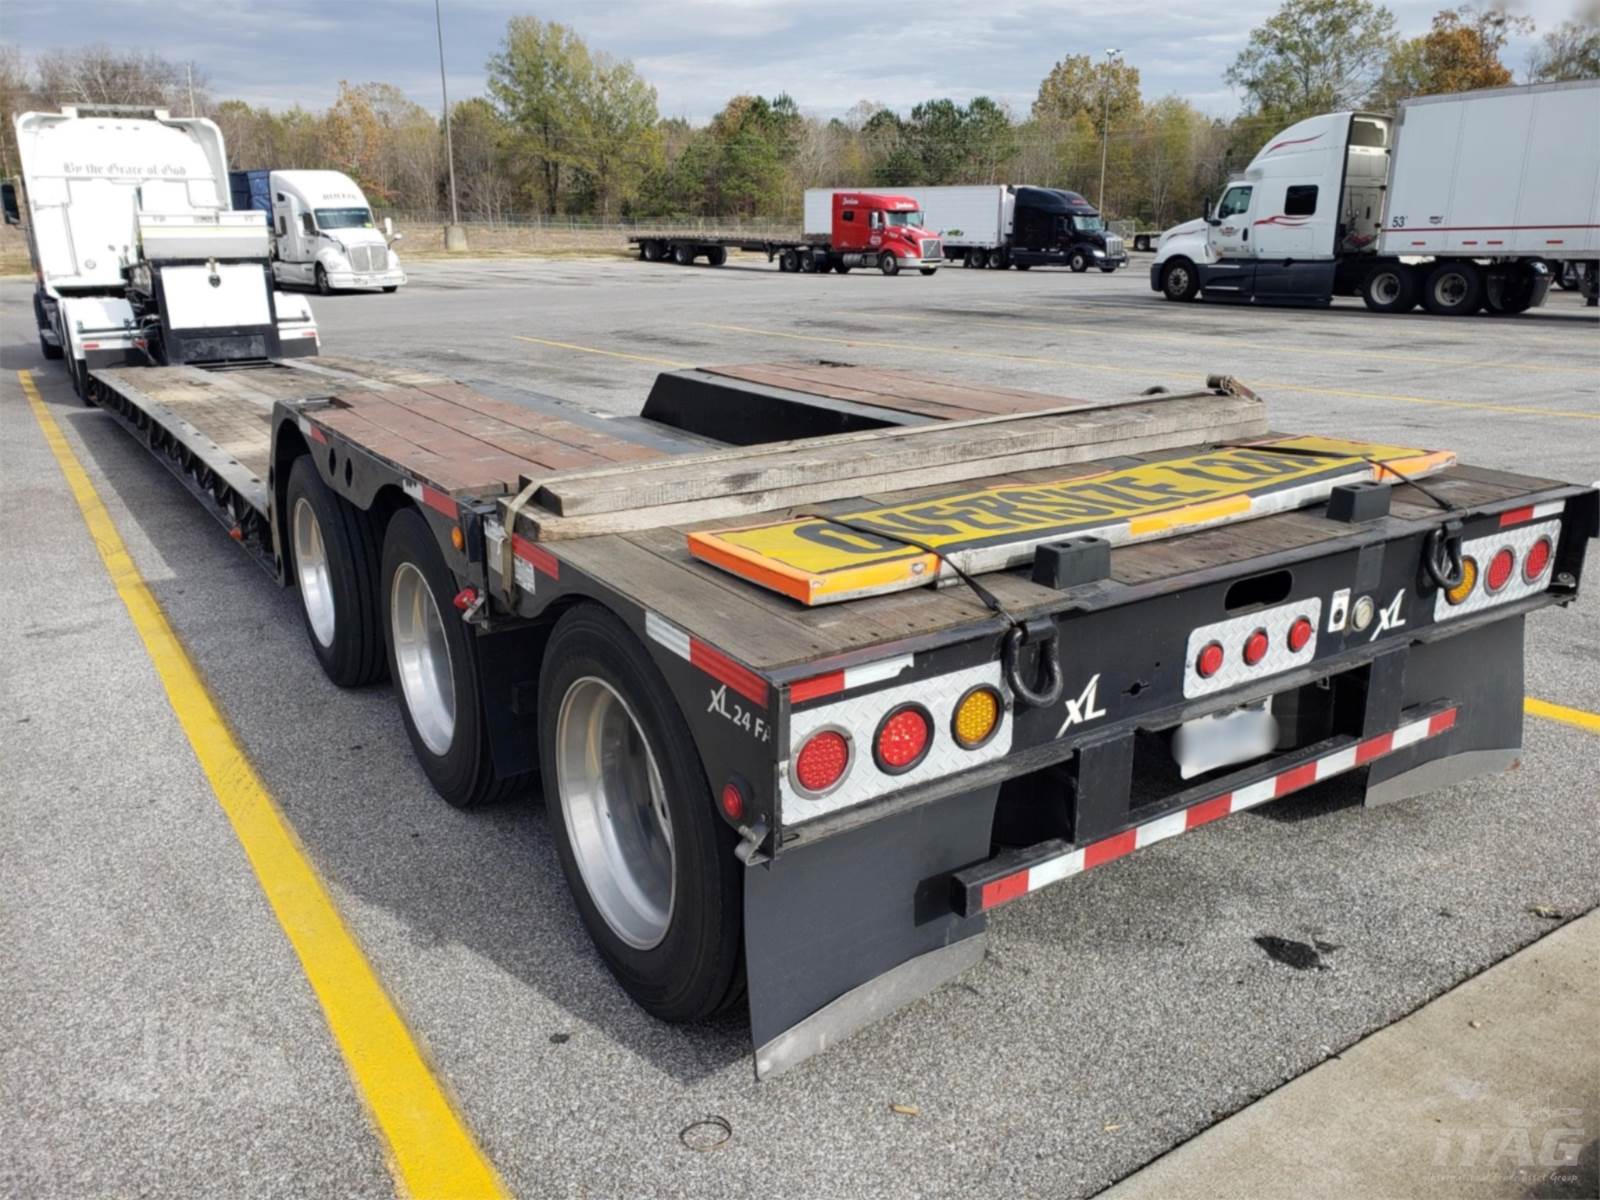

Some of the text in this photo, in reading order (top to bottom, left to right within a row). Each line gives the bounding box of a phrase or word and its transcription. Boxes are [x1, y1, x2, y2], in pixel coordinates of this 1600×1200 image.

[85, 163, 103, 175] the
[106, 162, 143, 175] Grace
[160, 163, 187, 176] God
[793, 474, 1220, 554] OVERSIZE
[1369, 587, 1407, 642] XL
[706, 683, 732, 719] XL
[732, 704, 751, 731] 24
[1055, 672, 1107, 739] XL
